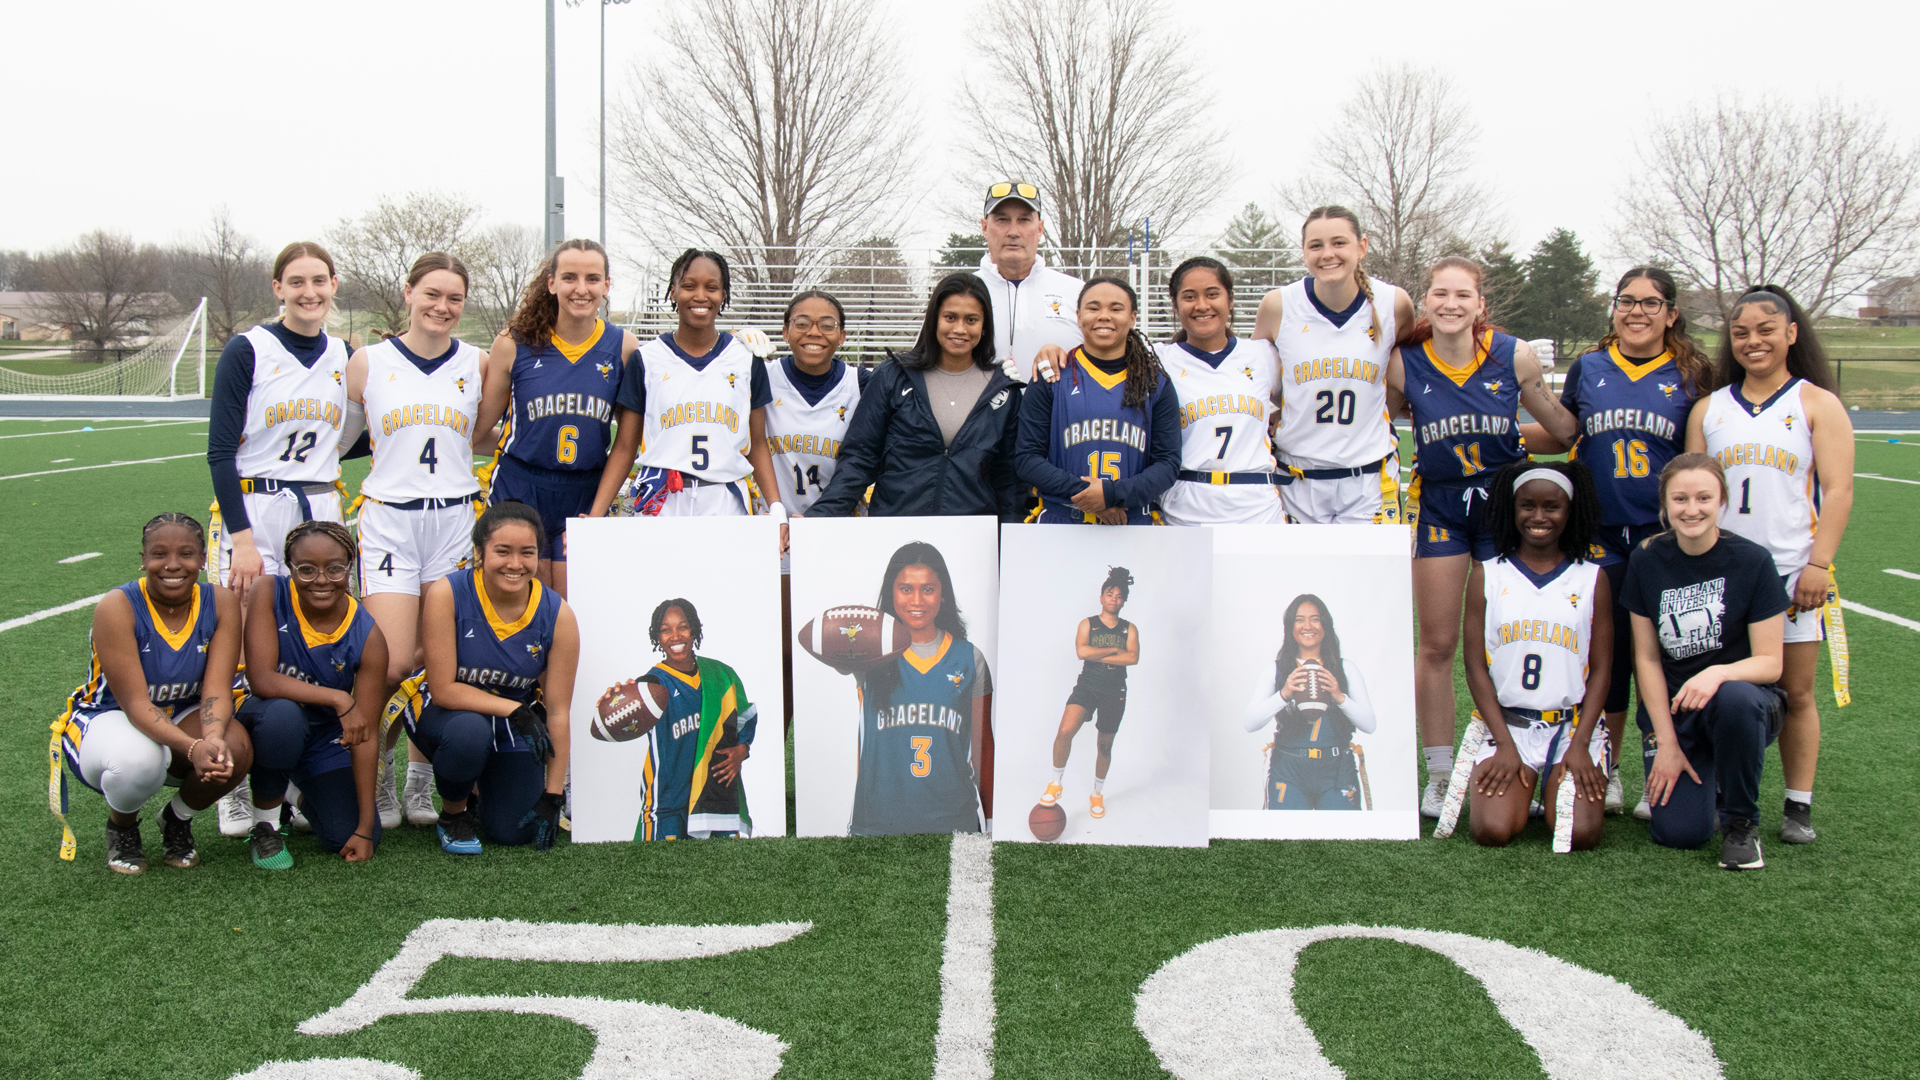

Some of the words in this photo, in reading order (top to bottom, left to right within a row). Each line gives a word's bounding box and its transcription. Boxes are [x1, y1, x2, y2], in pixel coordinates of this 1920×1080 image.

[1294, 357, 1379, 385] GRACELAND
[382, 404, 469, 438] GRACELAND
[527, 392, 612, 424] GRACELAND
[1179, 394, 1264, 429] GRACELAND
[1315, 388, 1357, 427] 20
[1586, 408, 1676, 440] GRACELAND
[556, 424, 580, 465] 6
[1214, 424, 1234, 461] 7
[1421, 414, 1510, 445] GRACELAND
[277, 429, 318, 465] 12
[417, 435, 439, 476] 4
[690, 433, 711, 473] 5
[766, 434, 842, 460] GRACELAN
[1453, 442, 1487, 477] 11
[1612, 438, 1650, 478] 16
[1716, 443, 1798, 476] RACELAND
[792, 461, 824, 497] 14
[1087, 450, 1122, 482] 15
[1737, 475, 1752, 517] 1
[377, 552, 395, 578] 4
[1660, 577, 1725, 602] GRACELAND
[1660, 589, 1724, 614] UNIVERSITY
[1668, 637, 1722, 660] OOTBALL
[1690, 621, 1722, 642] FLAG
[1829, 606, 1849, 685] GRACELAND
[457, 666, 537, 689] RACELAN
[1520, 651, 1544, 692] 8
[910, 735, 933, 778] 3
[1275, 781, 1287, 803] 7
